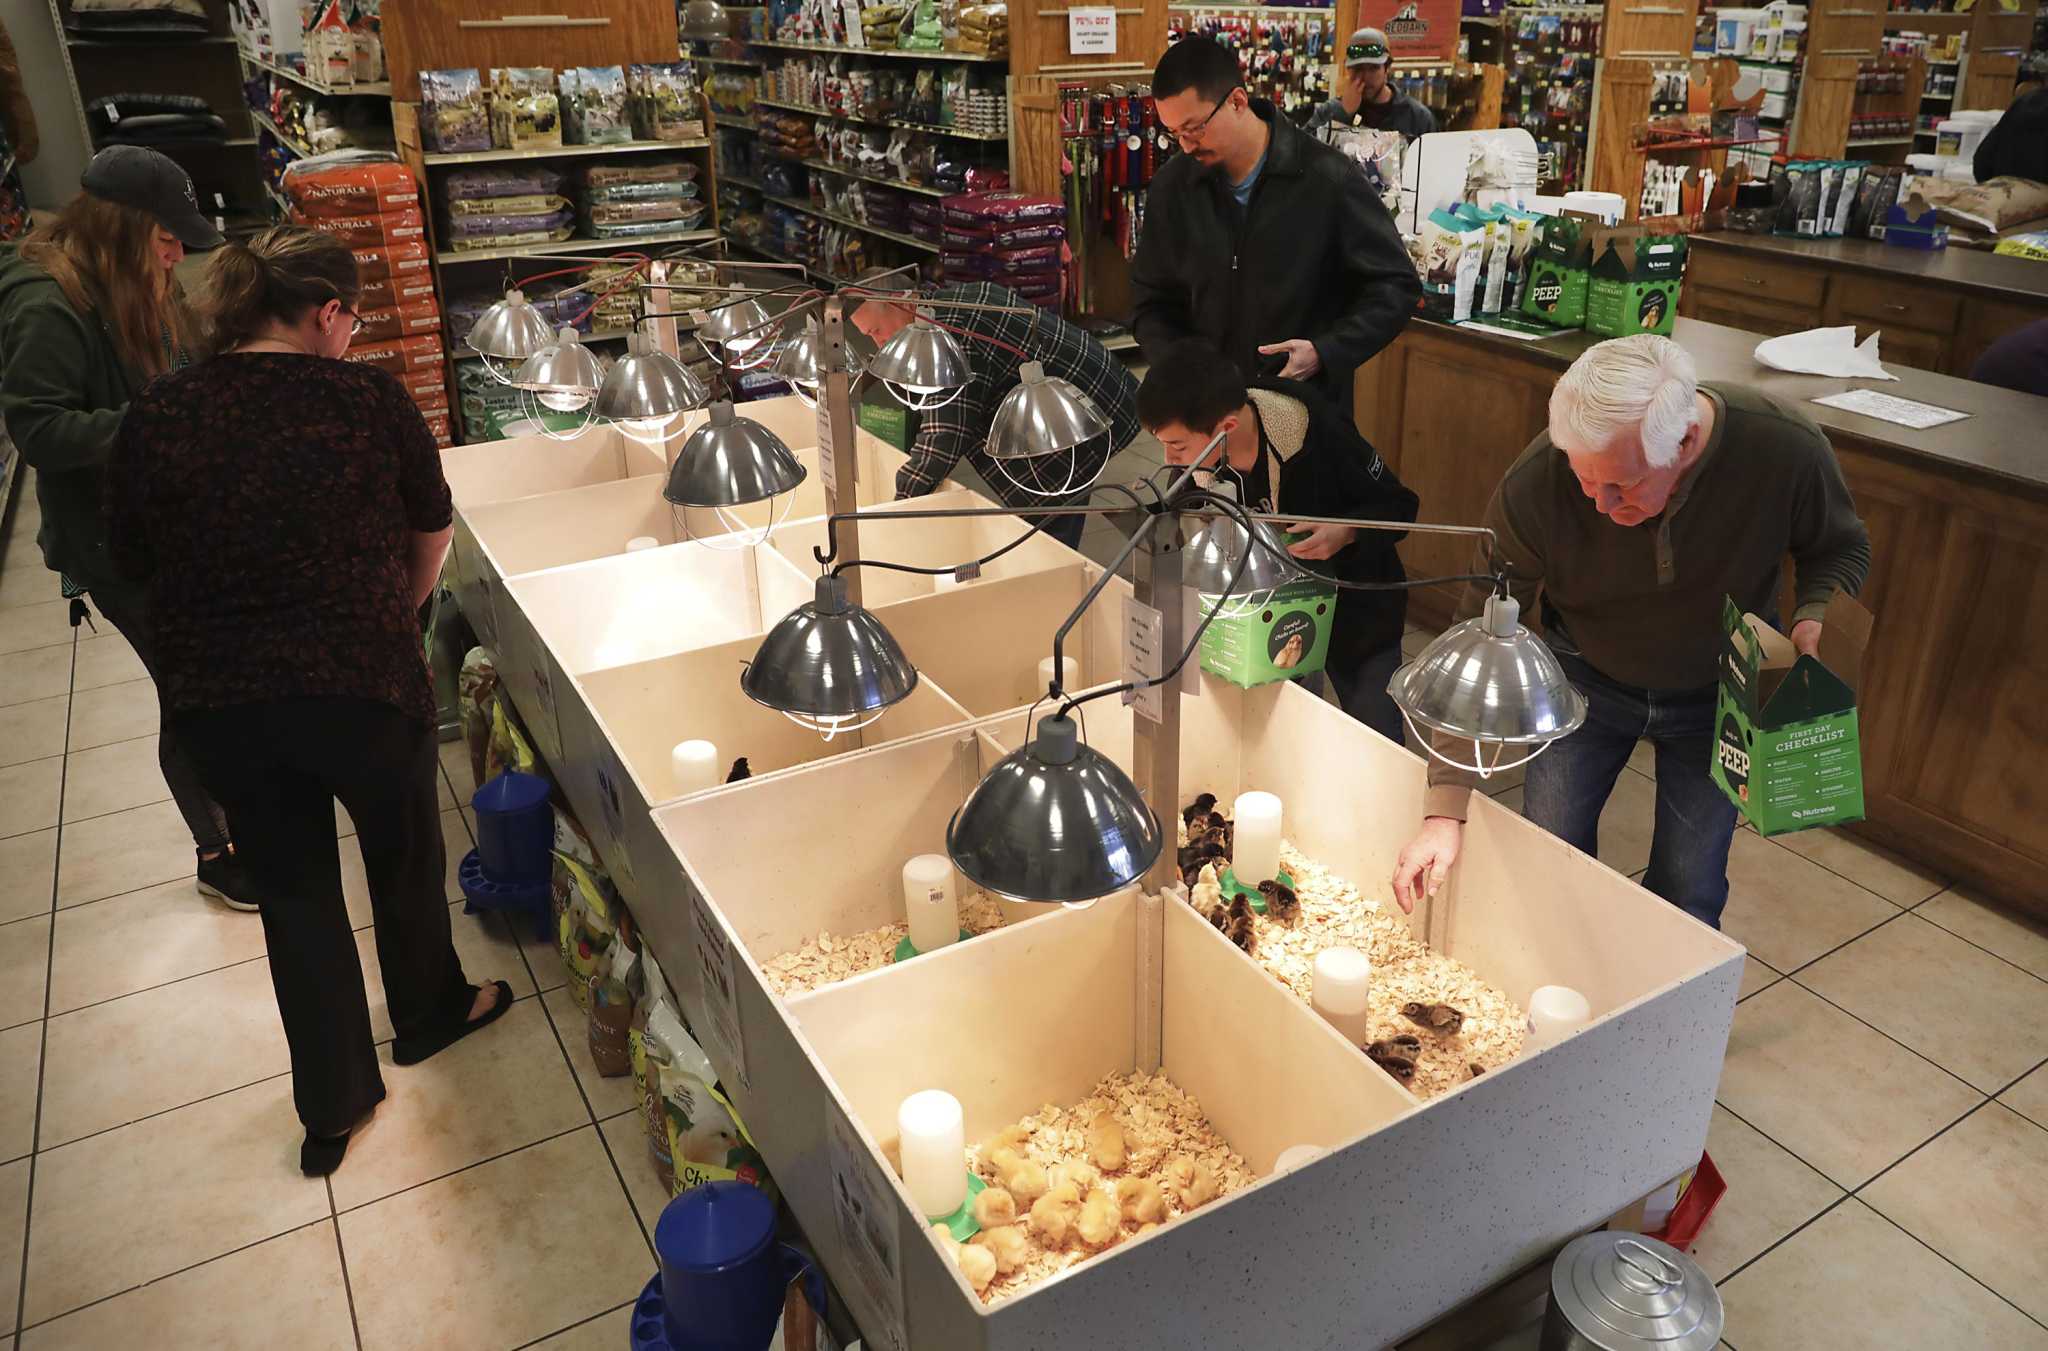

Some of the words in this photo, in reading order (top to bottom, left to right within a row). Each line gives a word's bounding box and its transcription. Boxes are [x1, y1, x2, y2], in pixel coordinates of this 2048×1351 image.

[1384, 21, 1427, 33] REDBARN
[312, 186, 367, 198] NATURALS
[318, 220, 373, 231] NATURALS
[1531, 286, 1562, 301] PEEP
[1790, 728, 1812, 740] FIRST
[1814, 724, 1832, 734] DAY
[1776, 729, 1845, 752] CHECKLIST
[1718, 739, 1750, 778] PEEP
